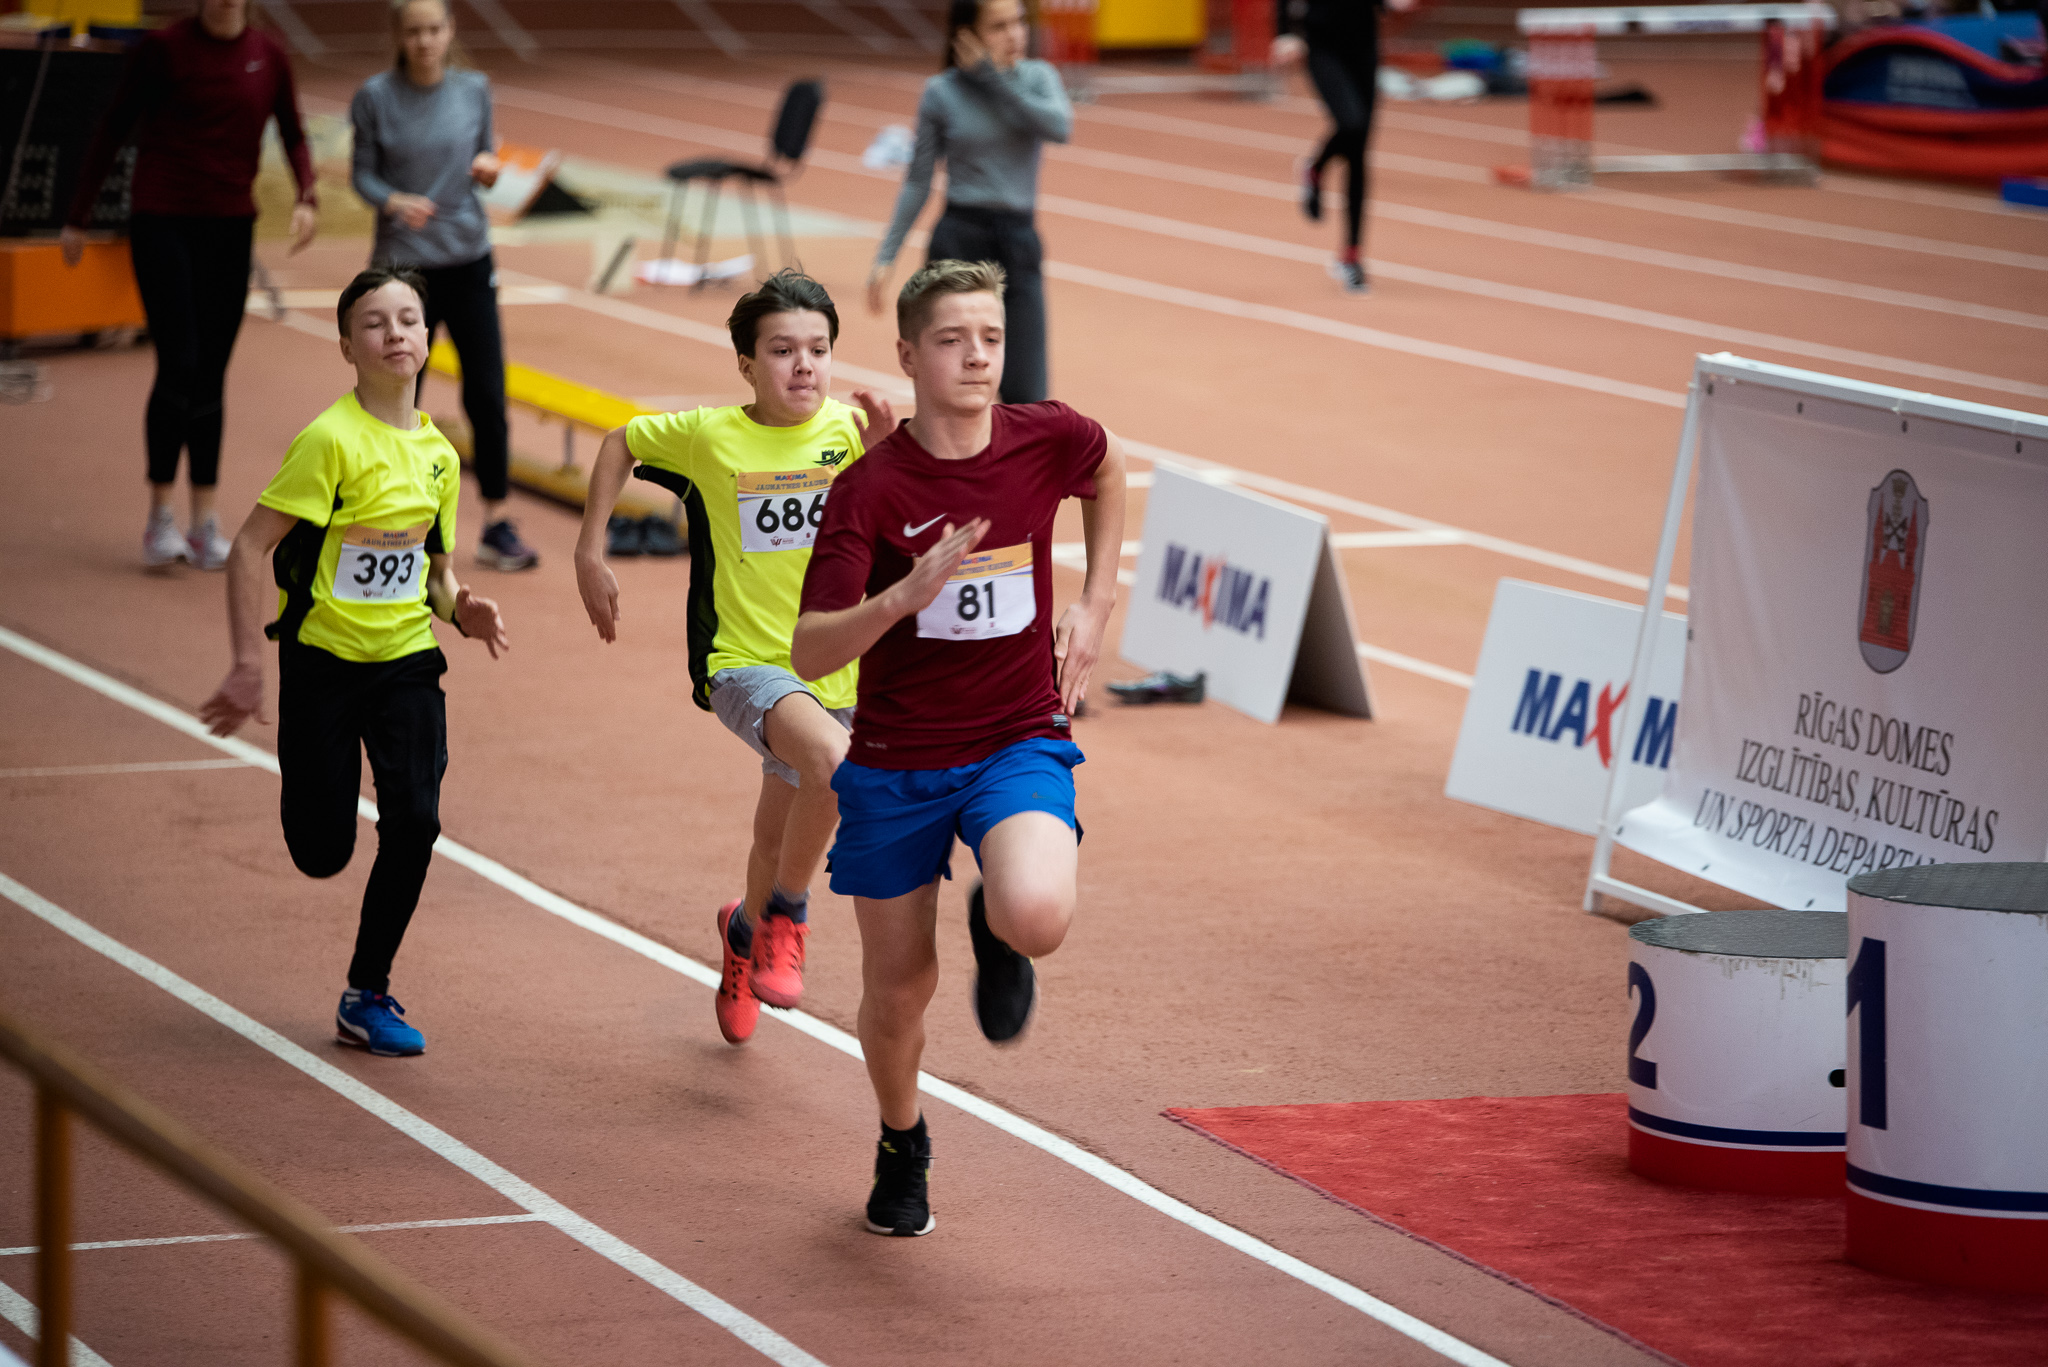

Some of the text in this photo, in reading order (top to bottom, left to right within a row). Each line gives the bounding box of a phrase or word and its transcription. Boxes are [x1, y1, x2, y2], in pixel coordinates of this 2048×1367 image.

[755, 493, 825, 534] 686
[774, 473, 808, 482] MAXIMA
[353, 552, 415, 587] 393
[957, 580, 995, 622] 81
[1157, 543, 1270, 641] MAXIMA
[1793, 691, 1954, 777] RĪGAS DOMES
[1692, 788, 1736, 833] UN
[1727, 800, 1817, 862] SPORTA
[1864, 776, 1999, 854] KULTŪRAS
[1628, 960, 1658, 1091] 2
[1846, 936, 1888, 1131] 1
